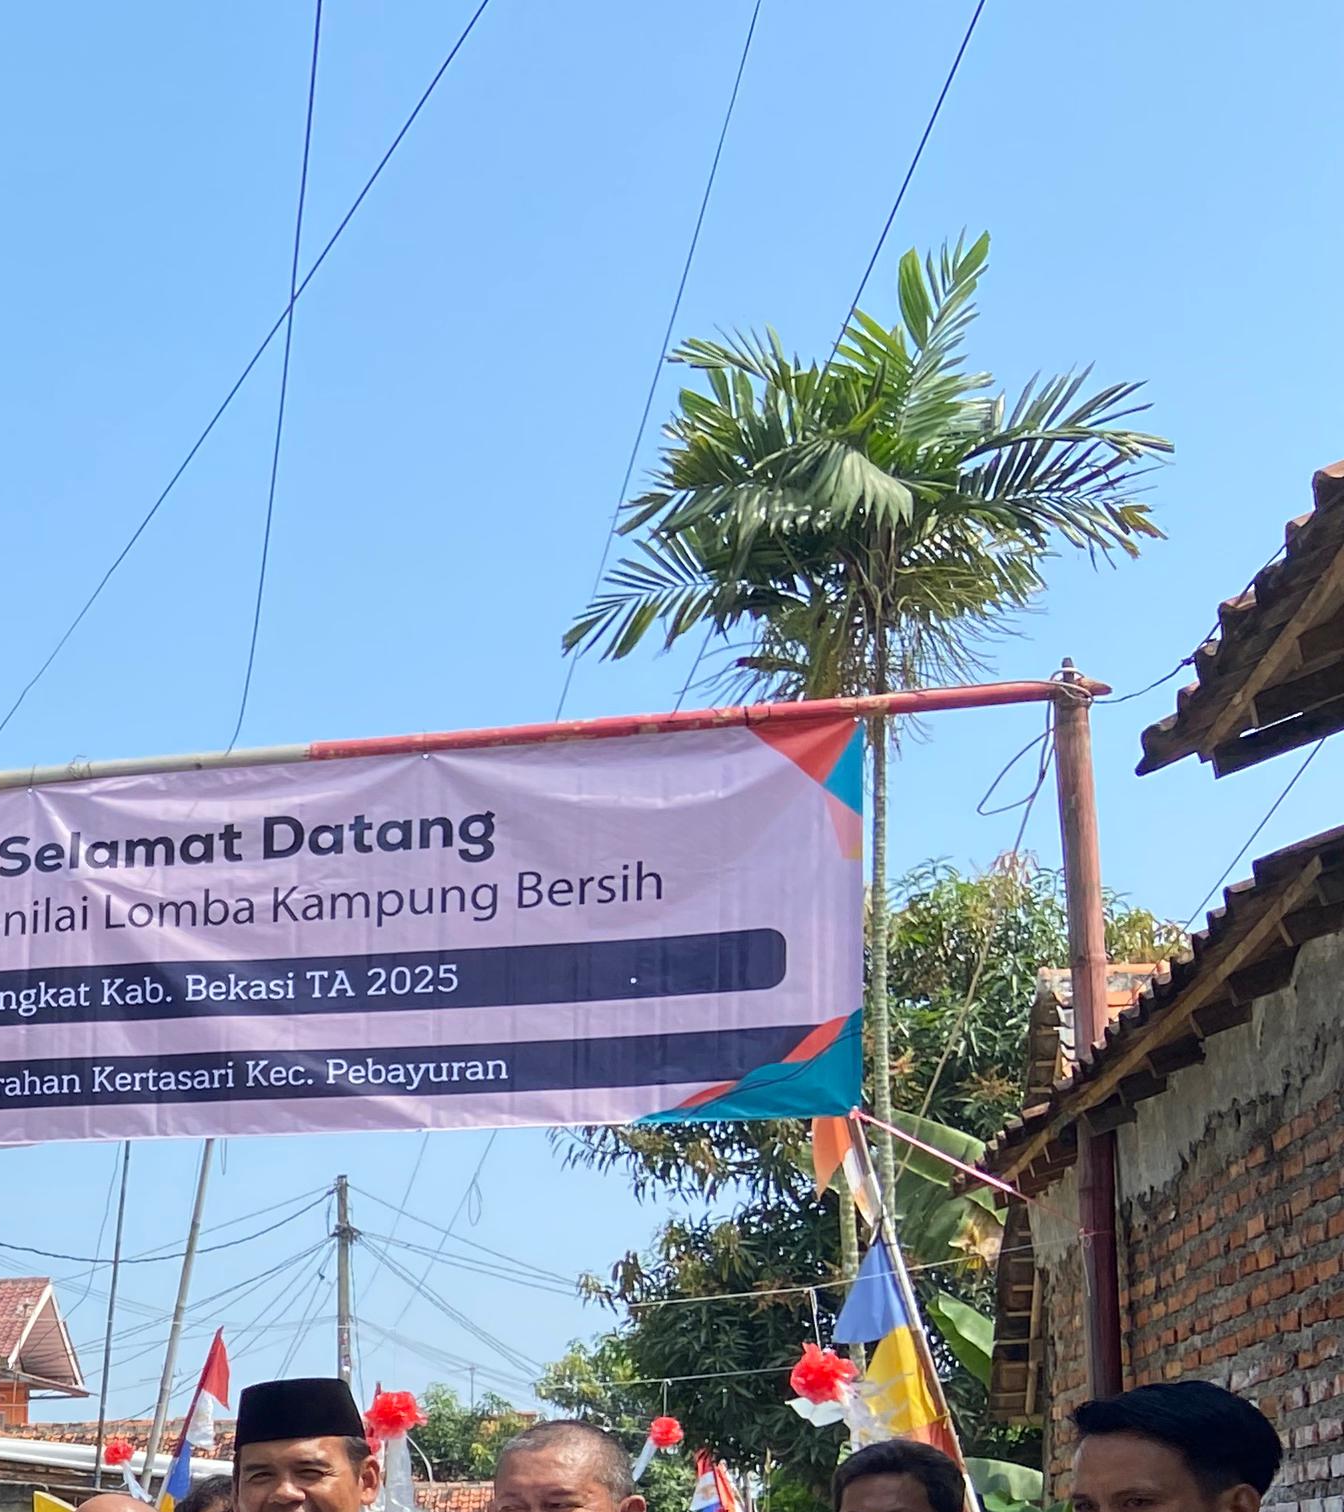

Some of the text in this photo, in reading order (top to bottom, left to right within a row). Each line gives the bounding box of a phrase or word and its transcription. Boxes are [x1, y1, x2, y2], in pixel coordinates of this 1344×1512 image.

[263, 810, 495, 863] Datang
[104, 888, 255, 929] Lomba
[272, 882, 498, 927] Kampung
[517, 860, 663, 908] Bersih
[100, 976, 172, 1006] Kab.
[184, 971, 296, 1002] Bekasi
[306, 969, 355, 999] TA
[366, 964, 459, 996] 2025
[91, 1061, 234, 1095] Kertasari
[246, 1059, 313, 1087] Kec.
[325, 1054, 508, 1092] Pebayuran
